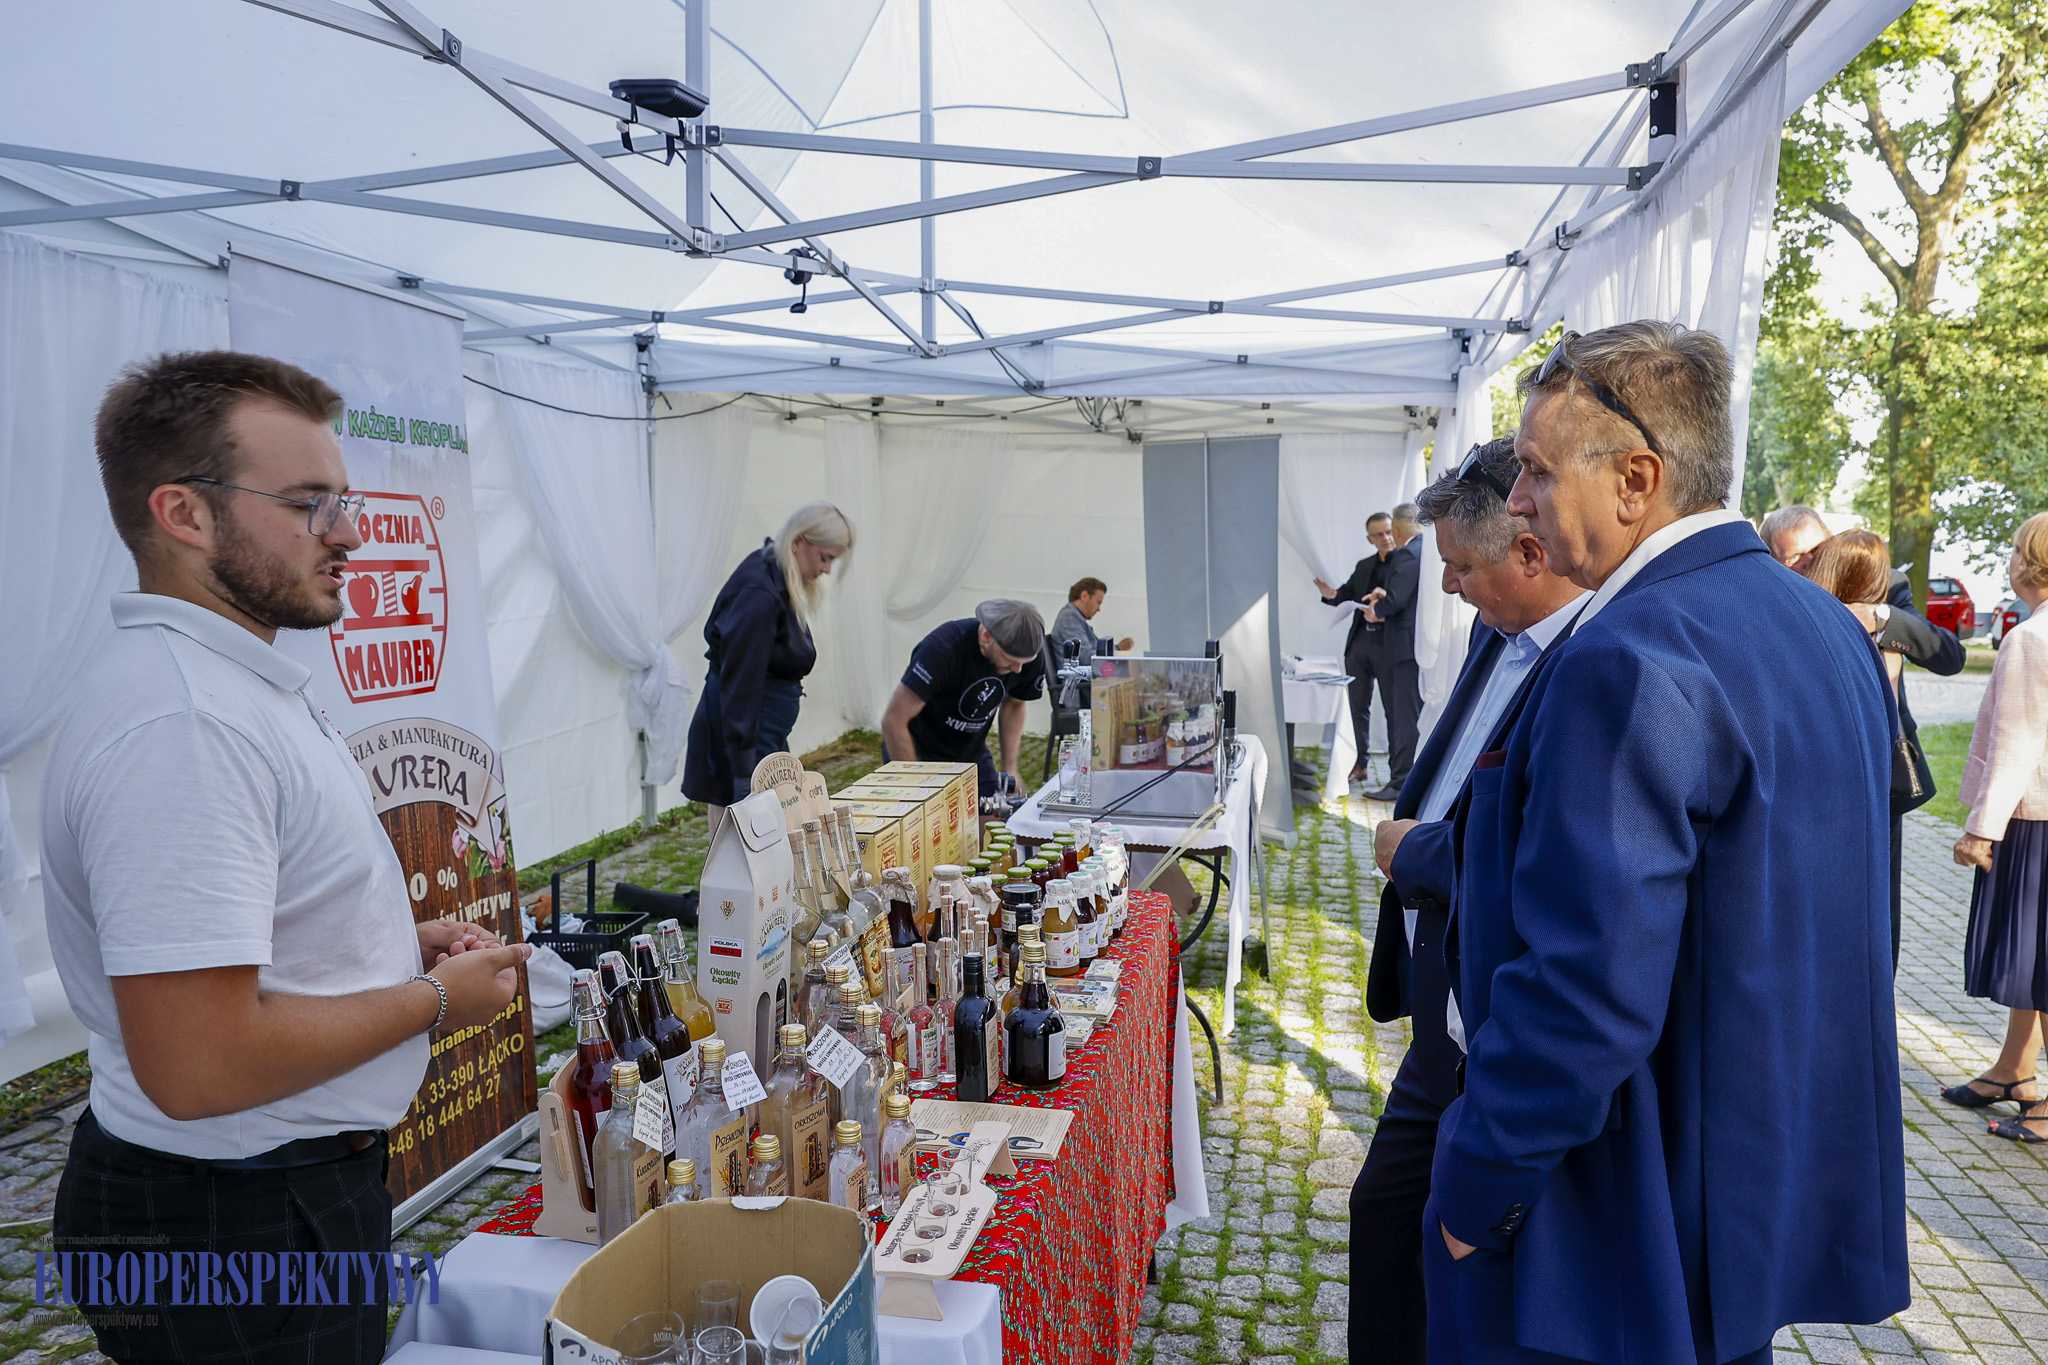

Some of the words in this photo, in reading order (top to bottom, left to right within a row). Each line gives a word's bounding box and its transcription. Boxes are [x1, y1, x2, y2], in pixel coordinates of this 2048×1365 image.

[348, 405, 405, 443] KAŻDEJ
[358, 513, 425, 544] OCZNIA
[344, 638, 435, 691] MAURER
[391, 727, 488, 770] MANUFAKTURA
[372, 754, 469, 806] URERA
[465, 891, 512, 922] warzyw
[429, 1061, 474, 1104] 33-390
[418, 1115, 436, 1141] 18
[438, 1096, 465, 1128] 444
[466, 1084, 483, 1111] 64
[486, 1073, 501, 1100] 27
[829, 1292, 853, 1330] APOLLO
